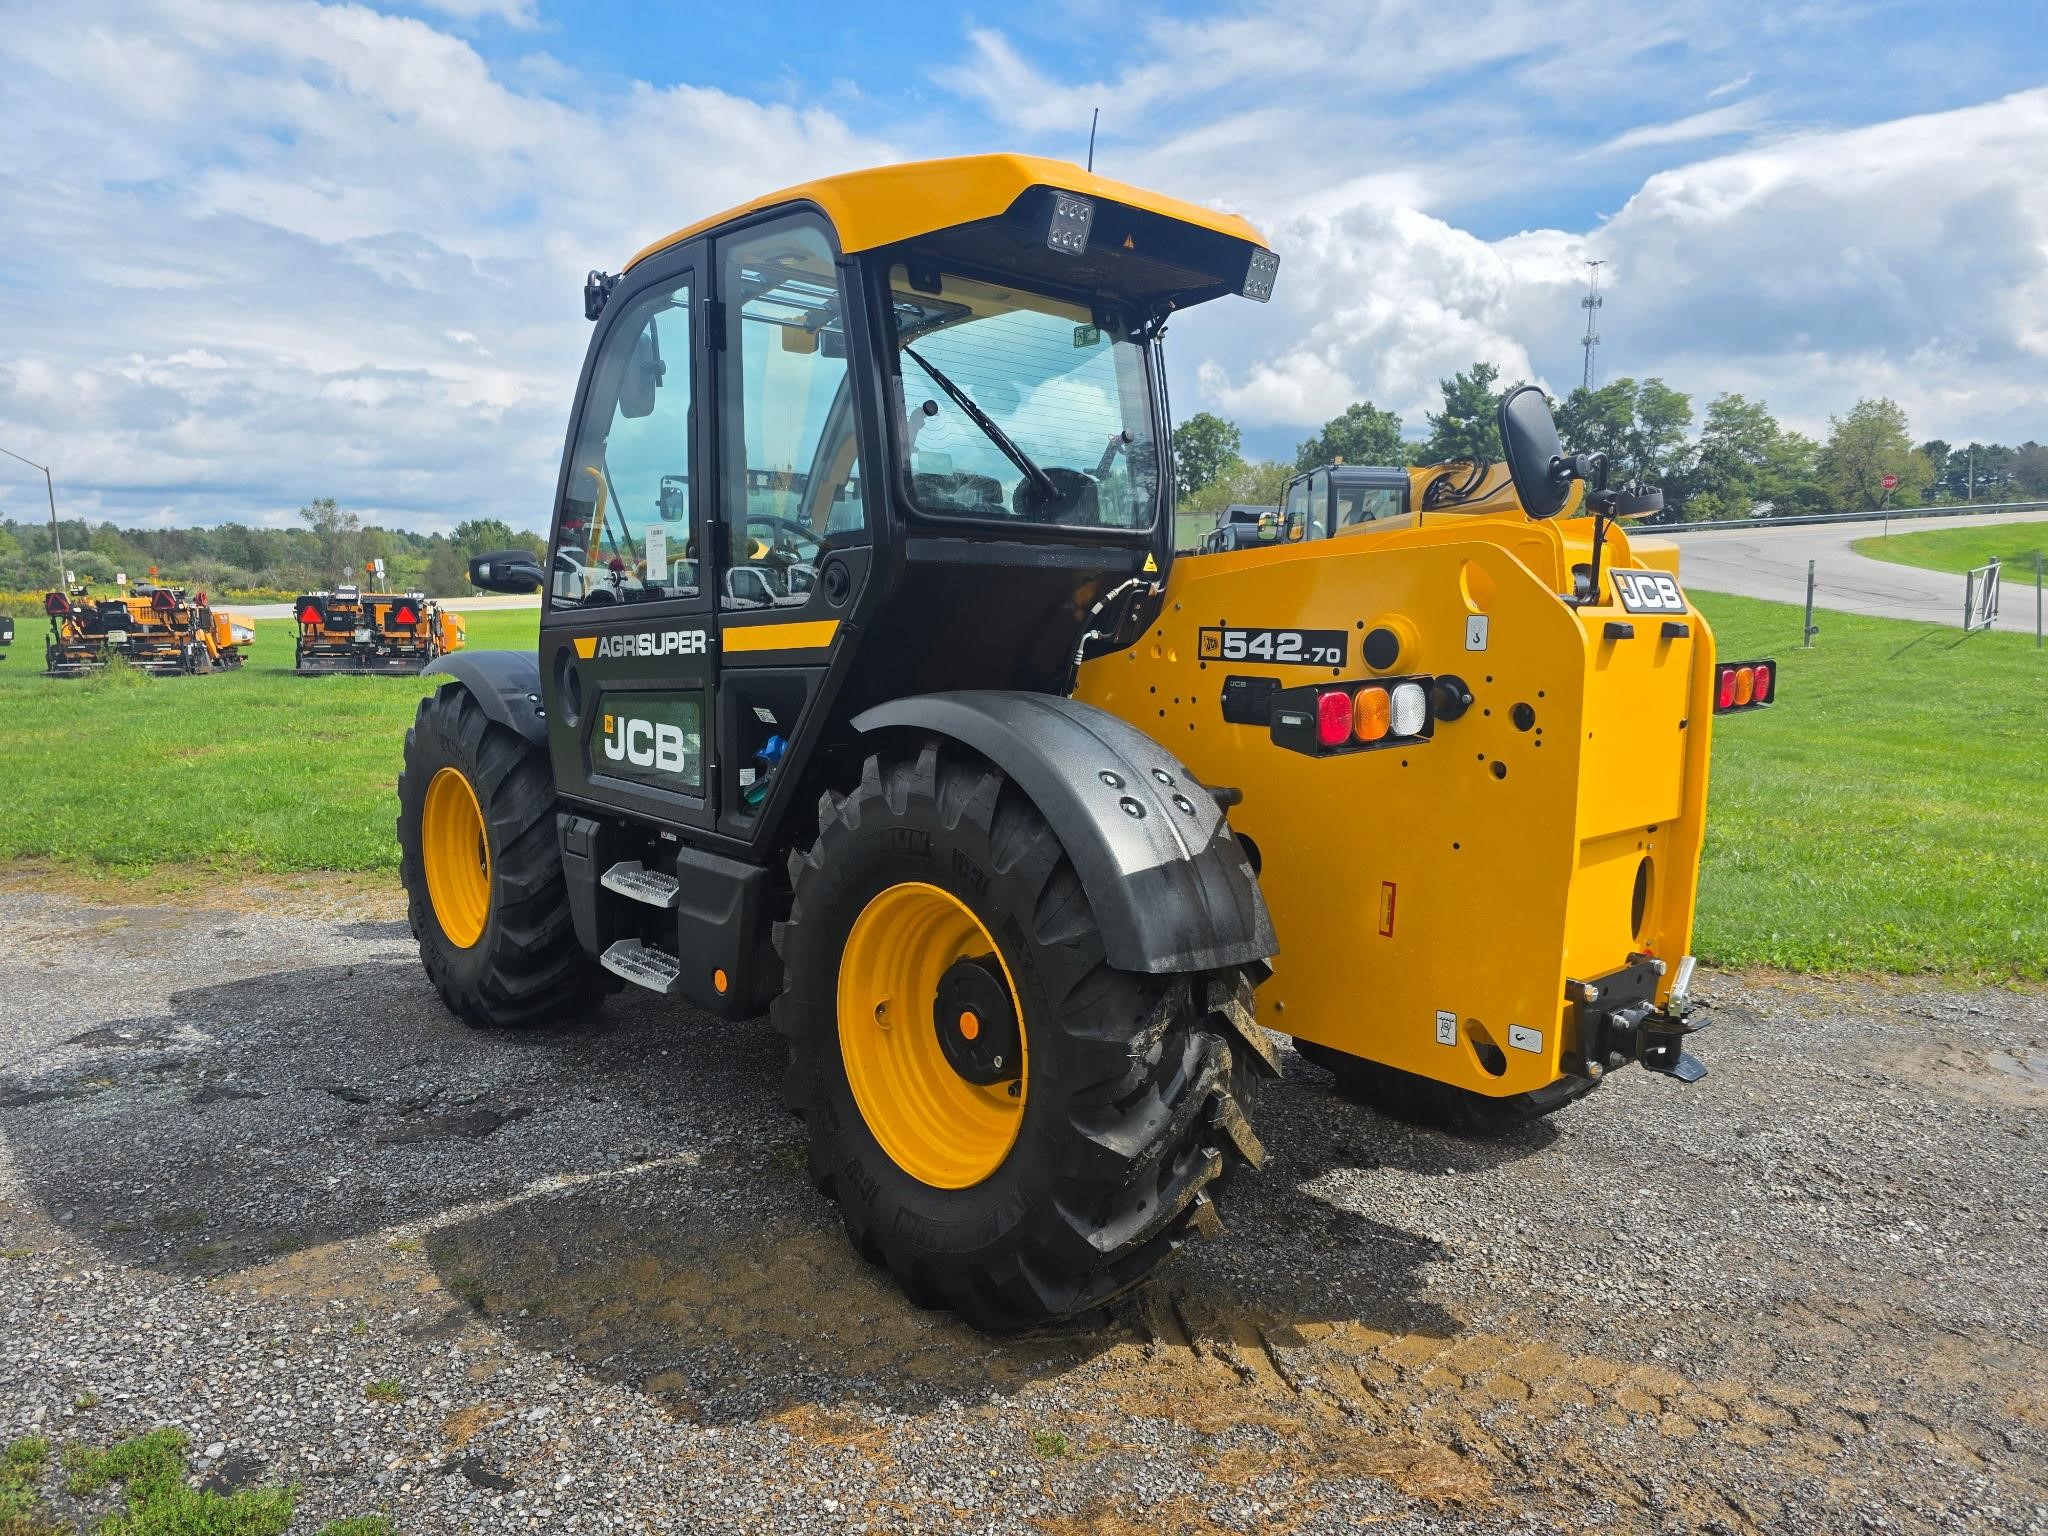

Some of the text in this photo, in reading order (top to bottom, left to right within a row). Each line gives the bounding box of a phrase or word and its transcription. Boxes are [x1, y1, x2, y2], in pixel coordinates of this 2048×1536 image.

[1619, 575, 1682, 609] JCB
[598, 629, 706, 659] AGRISUPER
[1229, 680, 1247, 688] JCB
[604, 715, 685, 773] JCB
